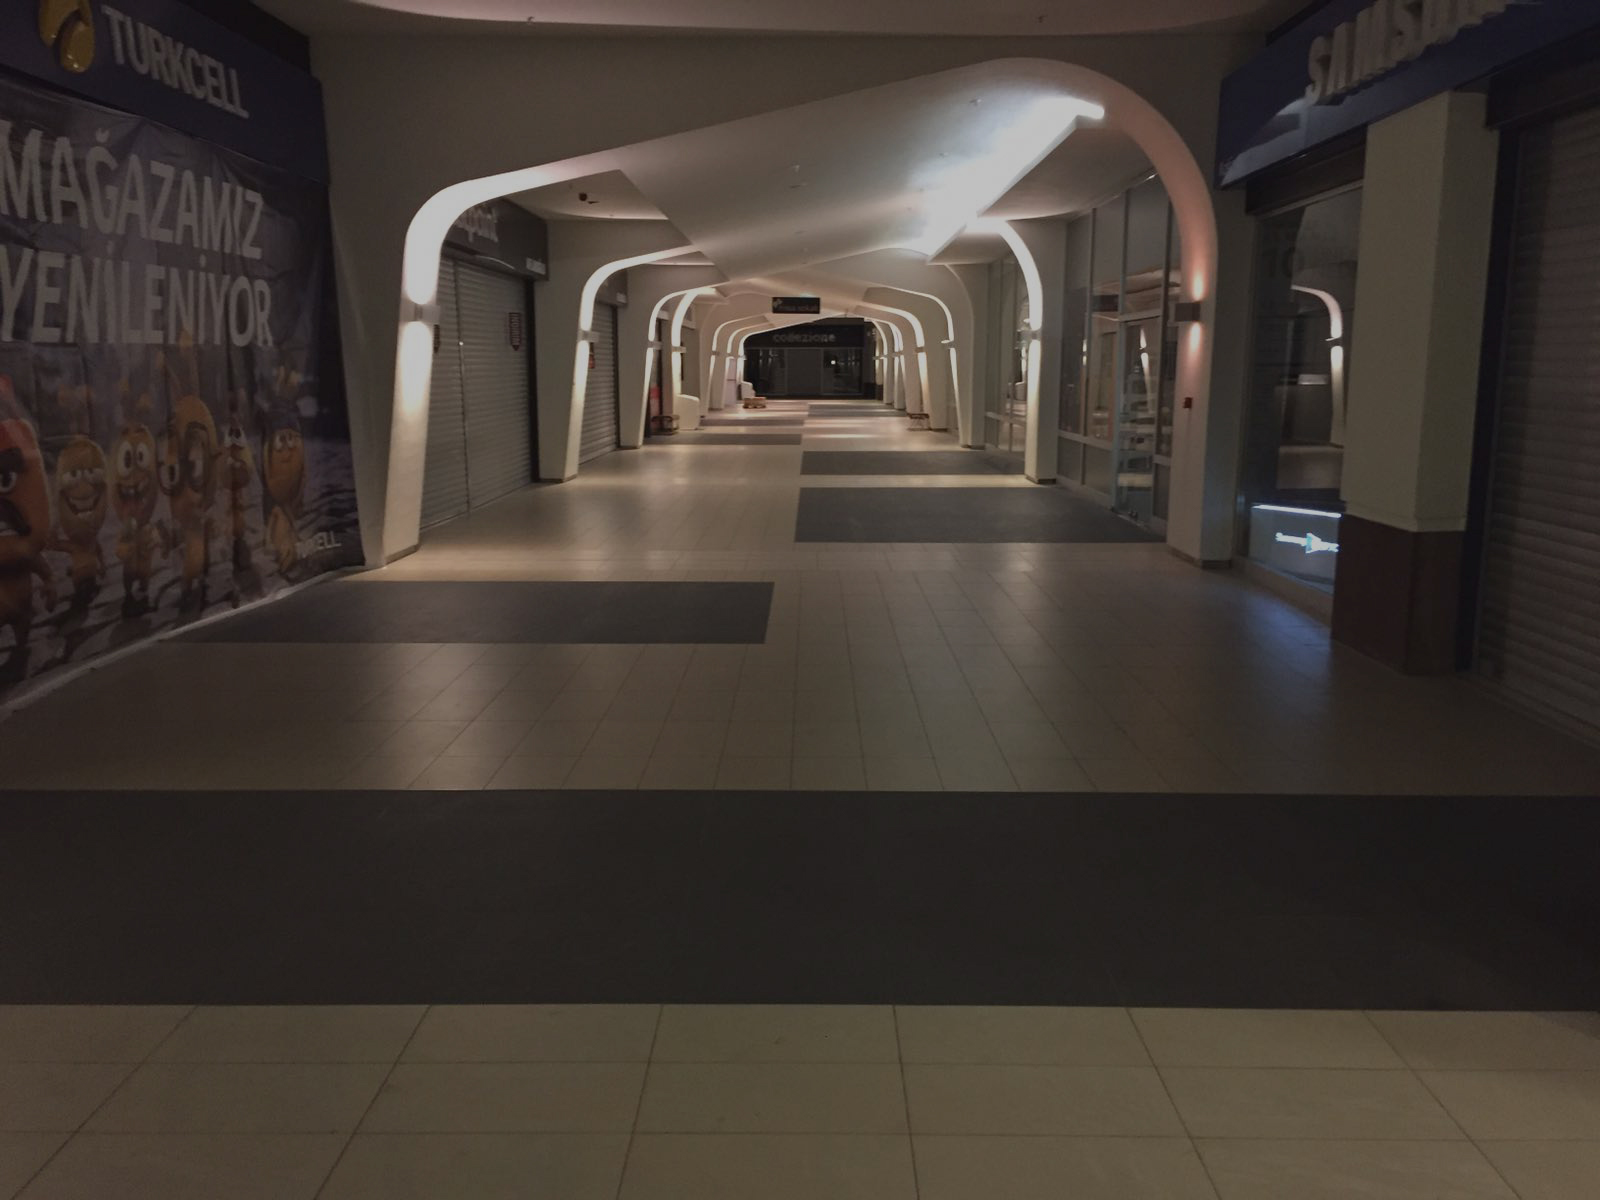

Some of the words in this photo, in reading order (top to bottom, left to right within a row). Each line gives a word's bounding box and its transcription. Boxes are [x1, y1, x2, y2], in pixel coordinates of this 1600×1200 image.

[101, 4, 250, 120] TURKCELL
[0, 119, 264, 261] MAĞAZAMIZ
[0, 240, 275, 349] YENİLENİYOR
